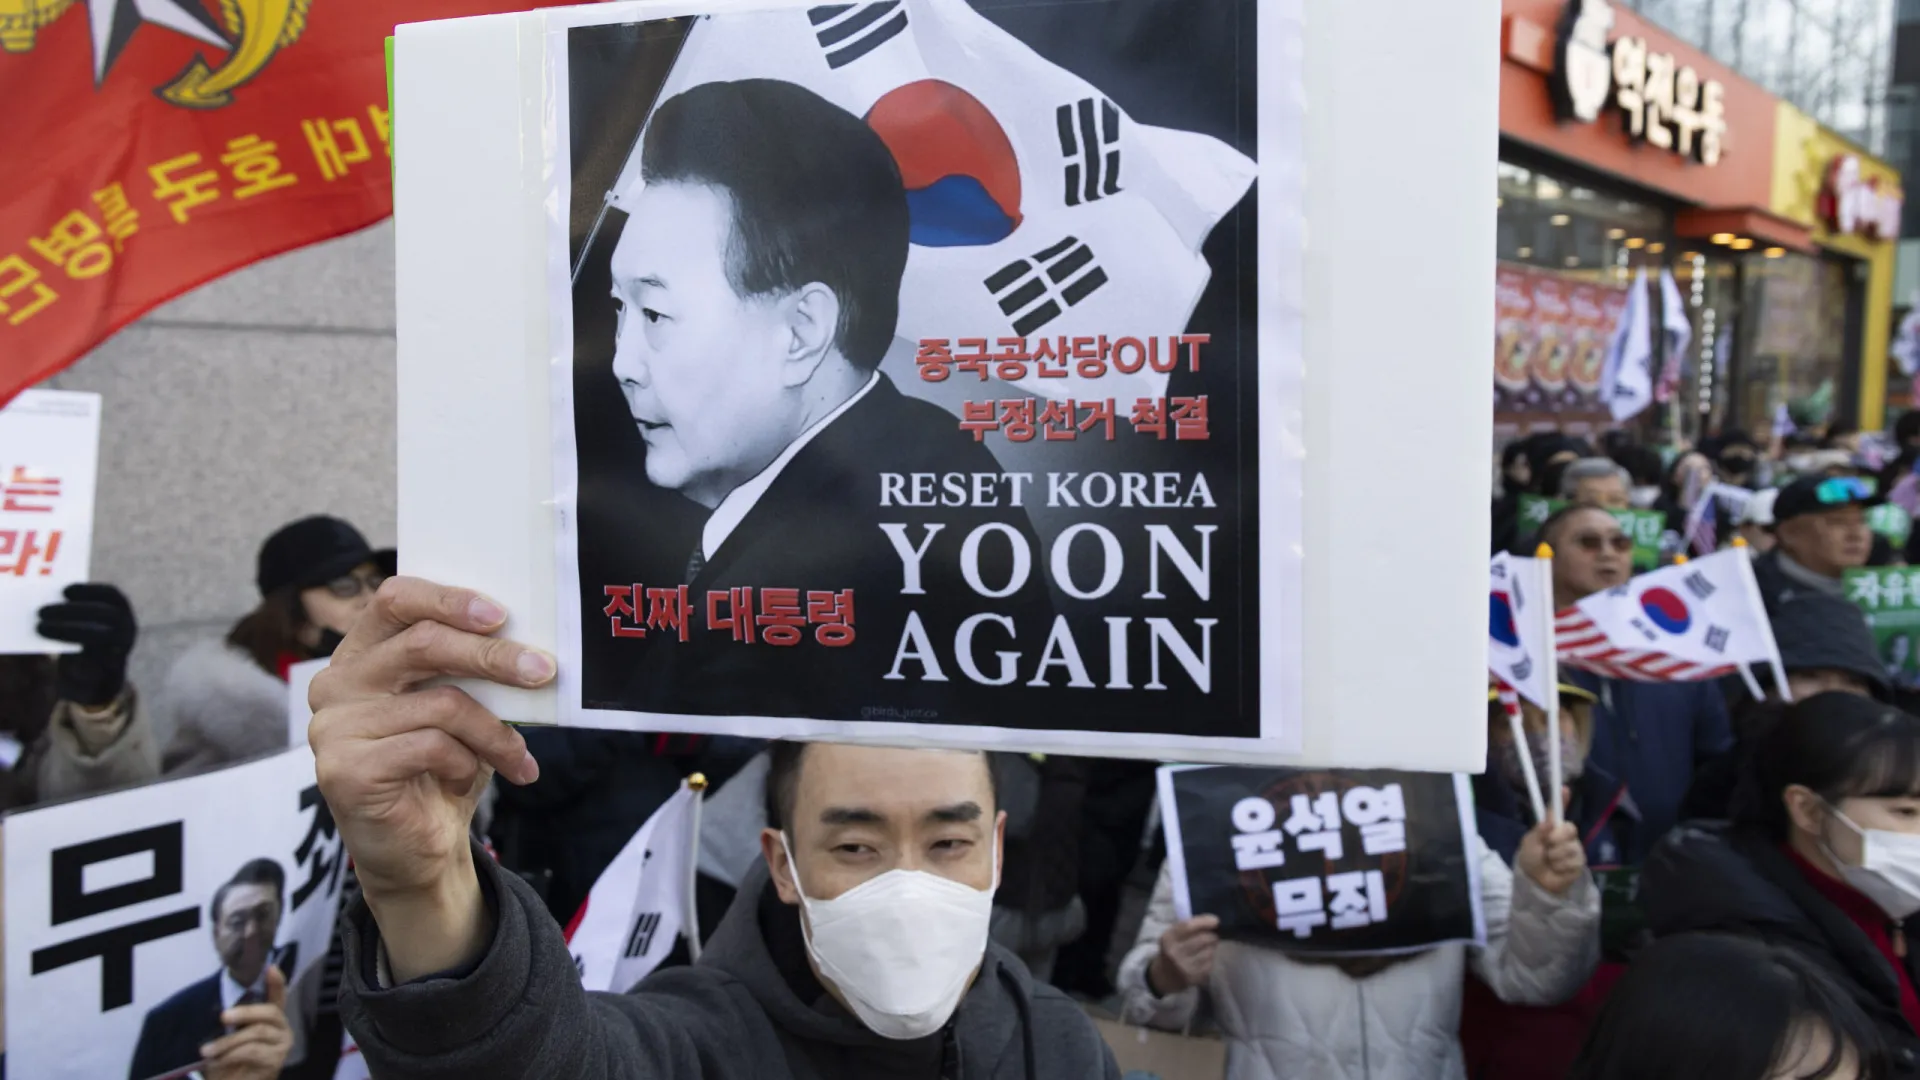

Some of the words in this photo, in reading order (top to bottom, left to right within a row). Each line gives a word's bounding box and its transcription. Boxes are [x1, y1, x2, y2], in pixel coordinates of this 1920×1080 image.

[1612, 35, 1727, 167] 역전우동
[915, 333, 1211, 382] 중국공산당OUT
[959, 397, 1116, 442] 부정선거
[1130, 395, 1211, 441] 척결
[879, 472, 1033, 507] RESET
[1047, 472, 1217, 508] KOREA
[878, 522, 1220, 602] YOON
[603, 584, 694, 642] 진짜
[706, 585, 856, 647] 대통령
[883, 611, 1218, 694] AGAIN
[1230, 783, 1406, 871] 윤석열
[1272, 869, 1388, 938] 무죄
